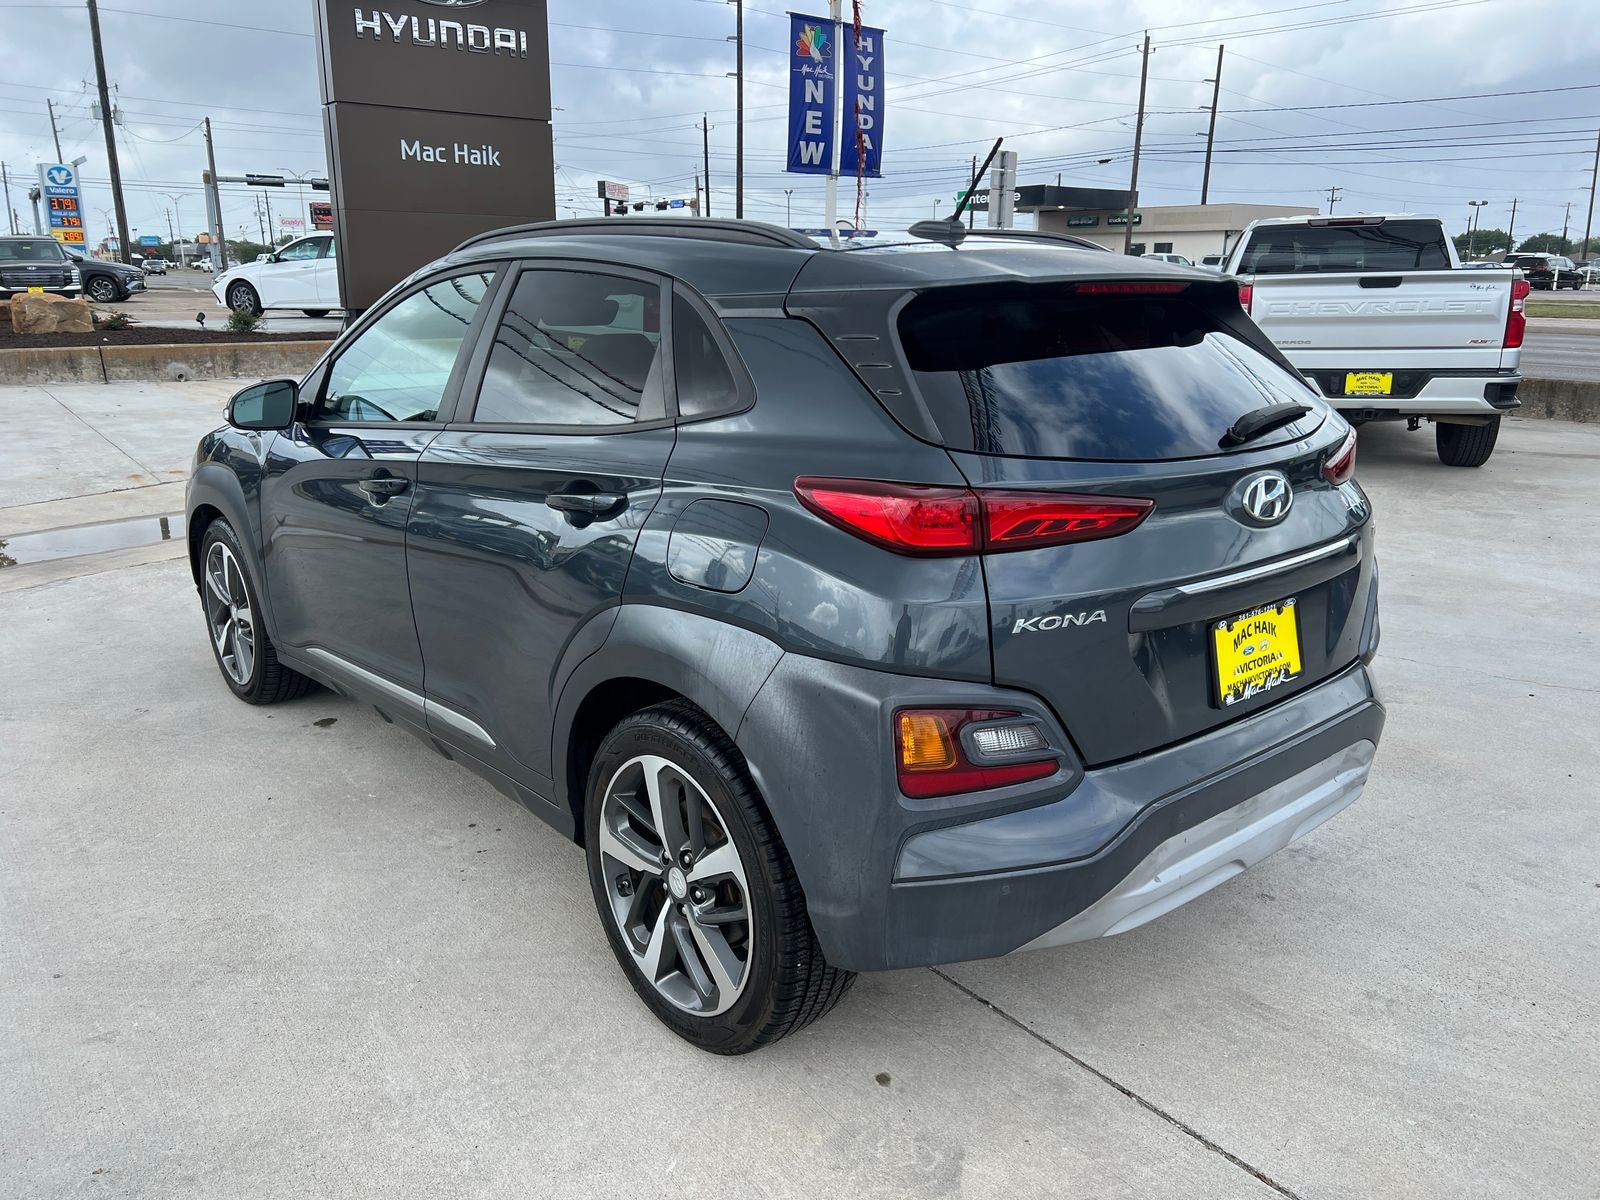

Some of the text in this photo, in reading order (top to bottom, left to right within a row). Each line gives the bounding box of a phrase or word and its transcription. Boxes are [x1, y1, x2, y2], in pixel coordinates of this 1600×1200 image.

[354, 8, 527, 58] HYUNDAI
[855, 36, 875, 168] HYUNDA
[800, 79, 825, 165] NEW
[400, 139, 501, 166] Mac Haik
[1268, 299, 1491, 316] CHEVROLET
[1012, 609, 1107, 634] KONA
[1233, 620, 1278, 653] MAC HAIK
[1239, 652, 1277, 674] VICTORIA
[1241, 669, 1292, 700] Mac Haik
